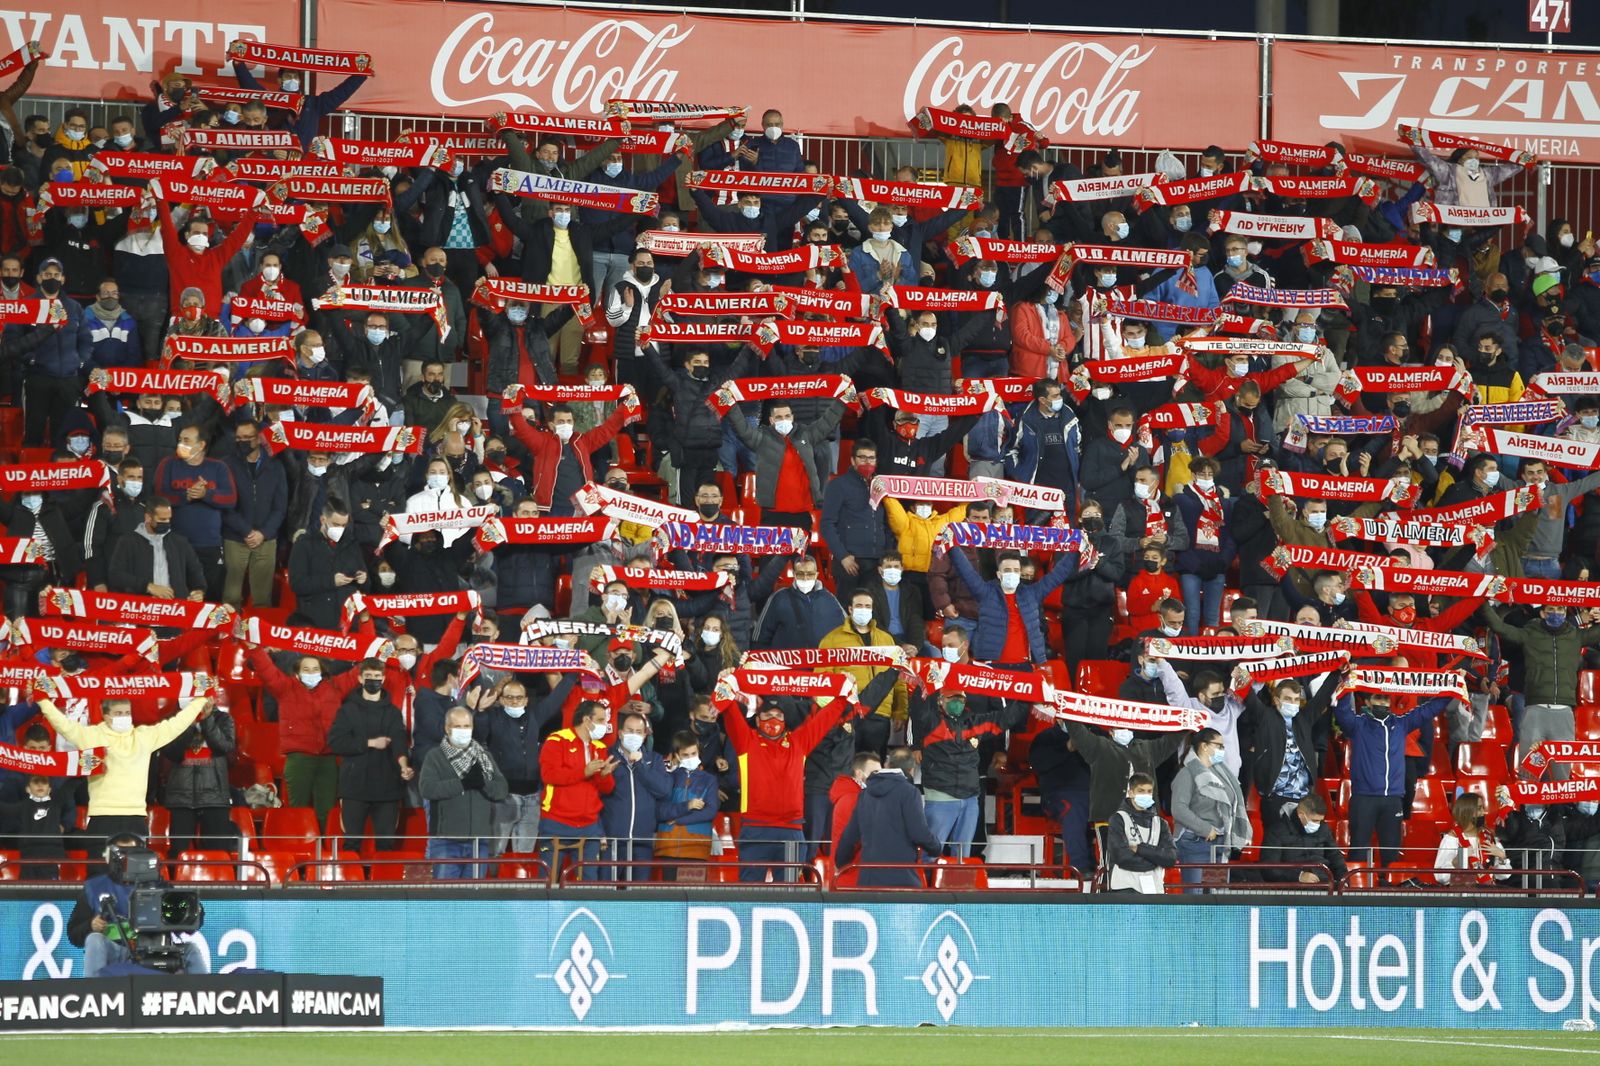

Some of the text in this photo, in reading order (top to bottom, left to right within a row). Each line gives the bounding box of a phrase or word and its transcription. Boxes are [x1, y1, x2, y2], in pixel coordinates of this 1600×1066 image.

[1531, 0, 1562, 29] 47
[430, 12, 695, 114] Coca-Cola
[904, 36, 1157, 137] Coca-Cola
[940, 115, 957, 127] UD
[1438, 136, 1454, 144] UD
[342, 144, 414, 158] UD ALMERÍA
[1262, 143, 1327, 159] UD ALMERÍA
[106, 157, 184, 171] UD ALMERÍA
[1349, 154, 1415, 174] UD ALMERÍA
[170, 182, 246, 199] UD ALMERÍA
[1169, 177, 1234, 196] UD ALMERÍA
[1279, 178, 1347, 190] UD ALMERÍA
[57, 188, 77, 198] UD
[871, 184, 943, 200] UD ALMERÍA
[538, 192, 616, 209] ORGULLO ROJIBLANCO
[989, 242, 1004, 252] UD
[1342, 246, 1408, 259] UD ALMERÍA
[737, 254, 753, 264] UD
[352, 288, 373, 302] UD
[906, 290, 978, 301] UD ALMERÍA
[834, 300, 852, 311] UD
[787, 324, 861, 337] UD ALMERÍA
[1226, 342, 1264, 350] QUIERO
[1099, 359, 1173, 375] UD ALMERÍA
[113, 370, 137, 388] UD
[1366, 370, 1443, 383] UD ALMERÍA
[272, 383, 348, 398] UD ALMERÍA
[748, 383, 767, 392] UD
[1004, 385, 1022, 393] UD
[904, 394, 977, 407] UD ALMERÍA
[294, 428, 375, 443] UD ALMERÍA
[5, 466, 93, 482] UD ALMERÍA
[889, 478, 978, 497] UD ALMERIA
[1301, 478, 1375, 493] UD ALMERÍA
[515, 520, 595, 534] UD ALMERÍA
[1365, 519, 1388, 537] UD
[1291, 547, 1313, 563] UD
[625, 567, 646, 577] UD
[1393, 573, 1469, 588] UD ALMERÍA
[1523, 584, 1544, 595] UD
[96, 598, 187, 617] UD ALMERÍA
[40, 626, 133, 645] UD ALMERÍA
[270, 625, 357, 650] UD ALMERÍA
[806, 649, 821, 664] DE
[827, 648, 886, 663] PRIMERA
[78, 676, 100, 688] UD
[747, 674, 831, 688] UD ALMERÍA
[1362, 670, 1386, 685] UD
[1517, 777, 1598, 795] UD ALMERÍA
[685, 906, 879, 1016] PDR
[1249, 907, 1424, 1011] Hotel
[1453, 909, 1501, 1012] &
[141, 991, 279, 1016] #FANCAM
[292, 991, 381, 1016] #FANCAM
